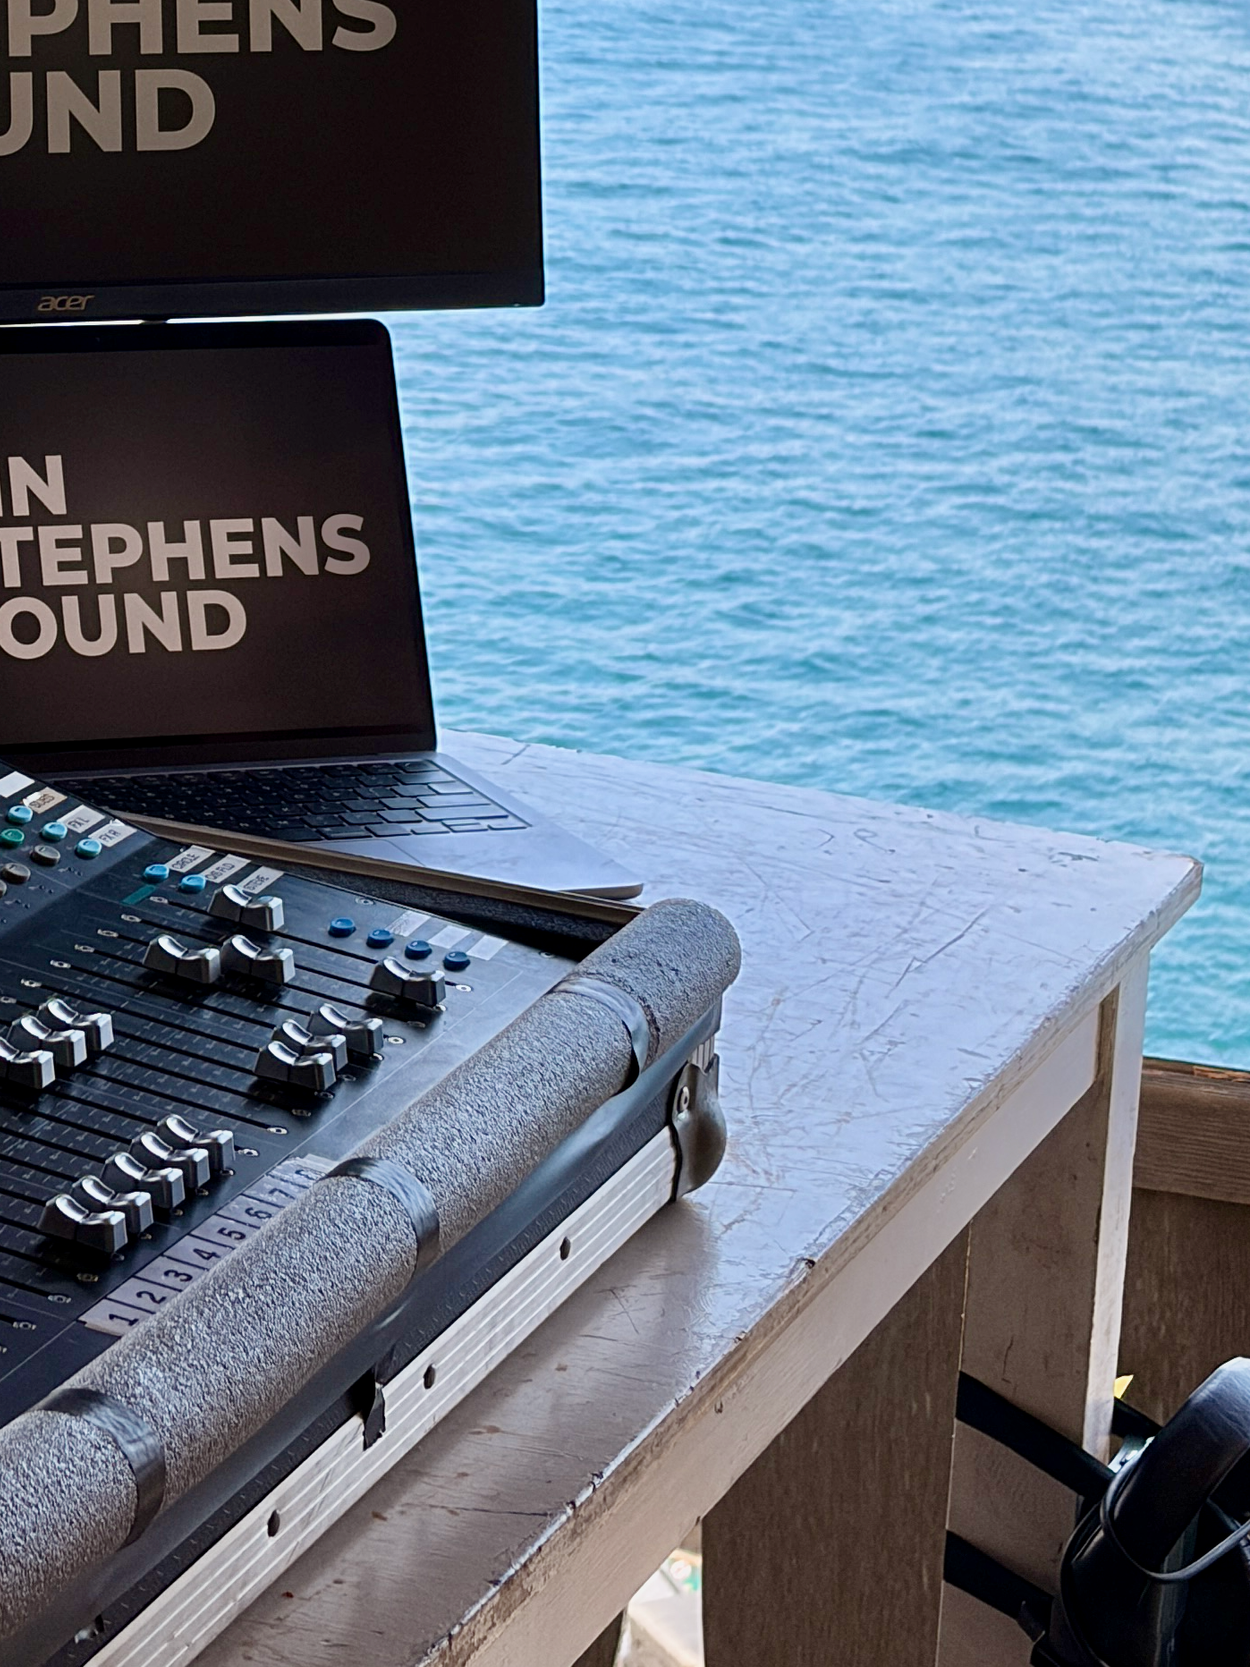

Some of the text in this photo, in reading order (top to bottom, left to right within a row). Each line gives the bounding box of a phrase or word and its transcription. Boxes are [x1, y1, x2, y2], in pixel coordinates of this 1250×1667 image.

[37, 295, 95, 311] acer
[108, 1313, 139, 1327] 1
[136, 1290, 167, 1304] 2
[164, 1269, 193, 1282] 3
[192, 1247, 221, 1261] 4
[217, 1226, 247, 1241] 5
[245, 1206, 273, 1220] 6
[268, 1187, 296, 1200] 7
